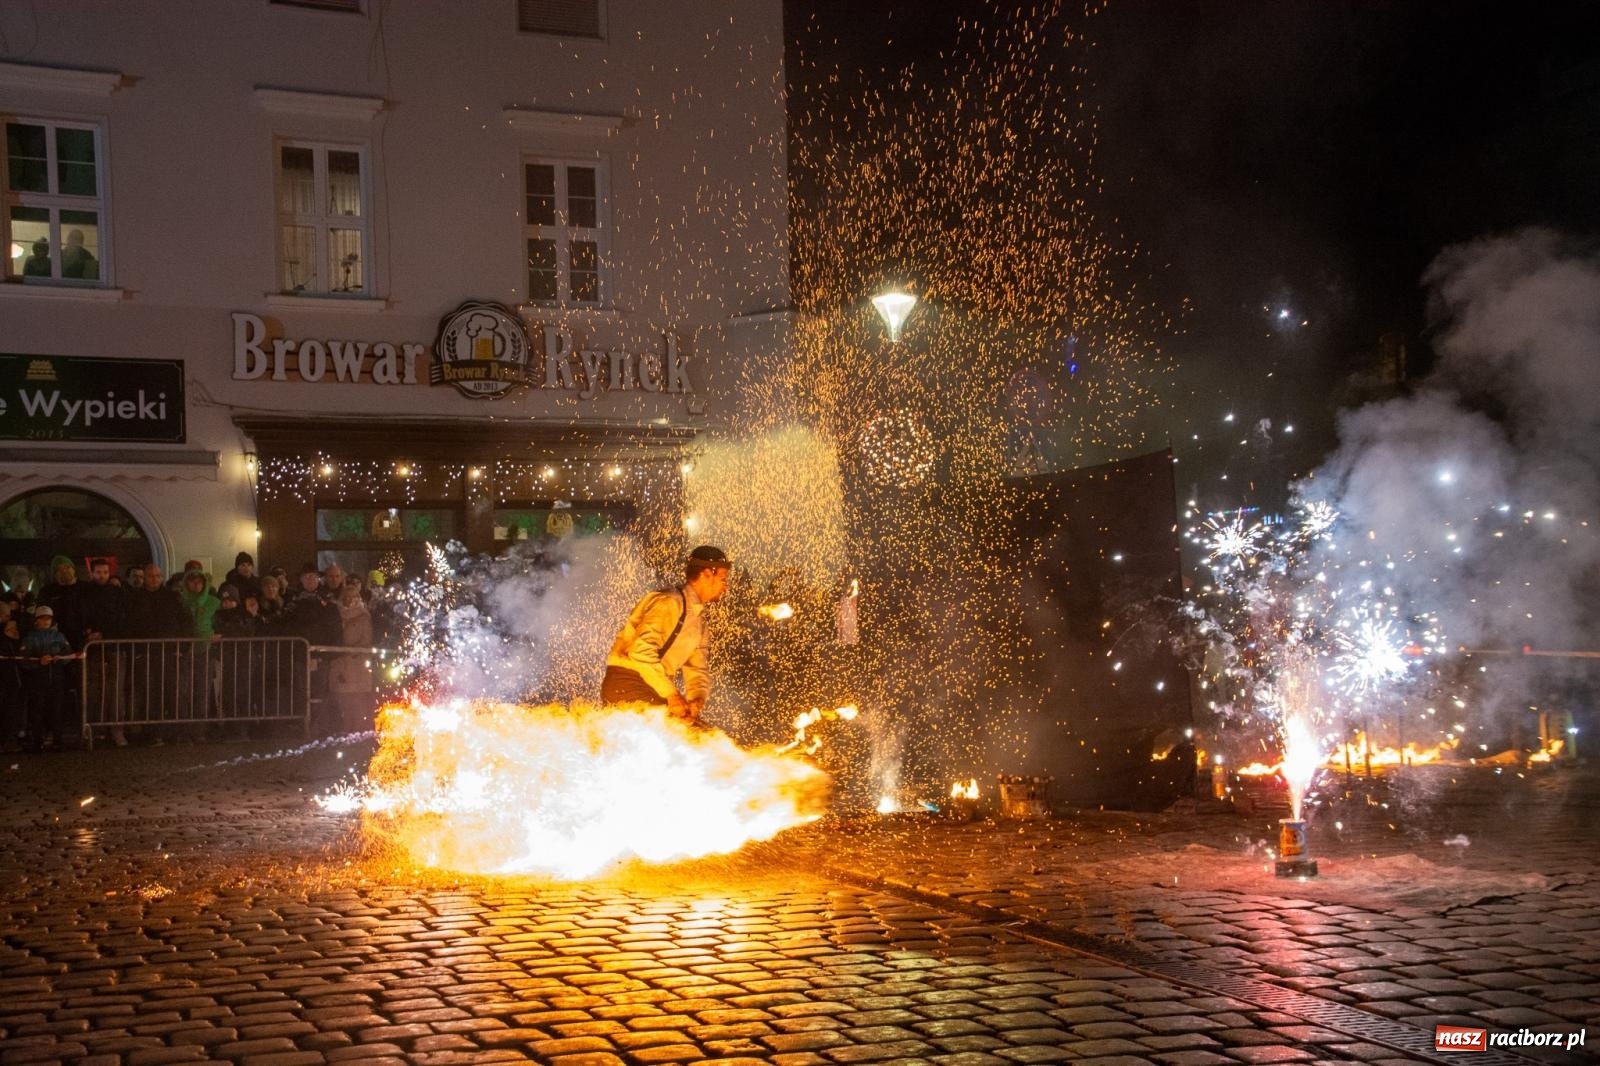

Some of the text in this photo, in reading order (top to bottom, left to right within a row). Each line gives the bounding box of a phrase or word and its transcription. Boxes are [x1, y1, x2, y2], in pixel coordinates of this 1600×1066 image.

[231, 312, 694, 400] Browar Rynek
[443, 363, 487, 380] Browar
[18, 388, 167, 427] Wypieki
